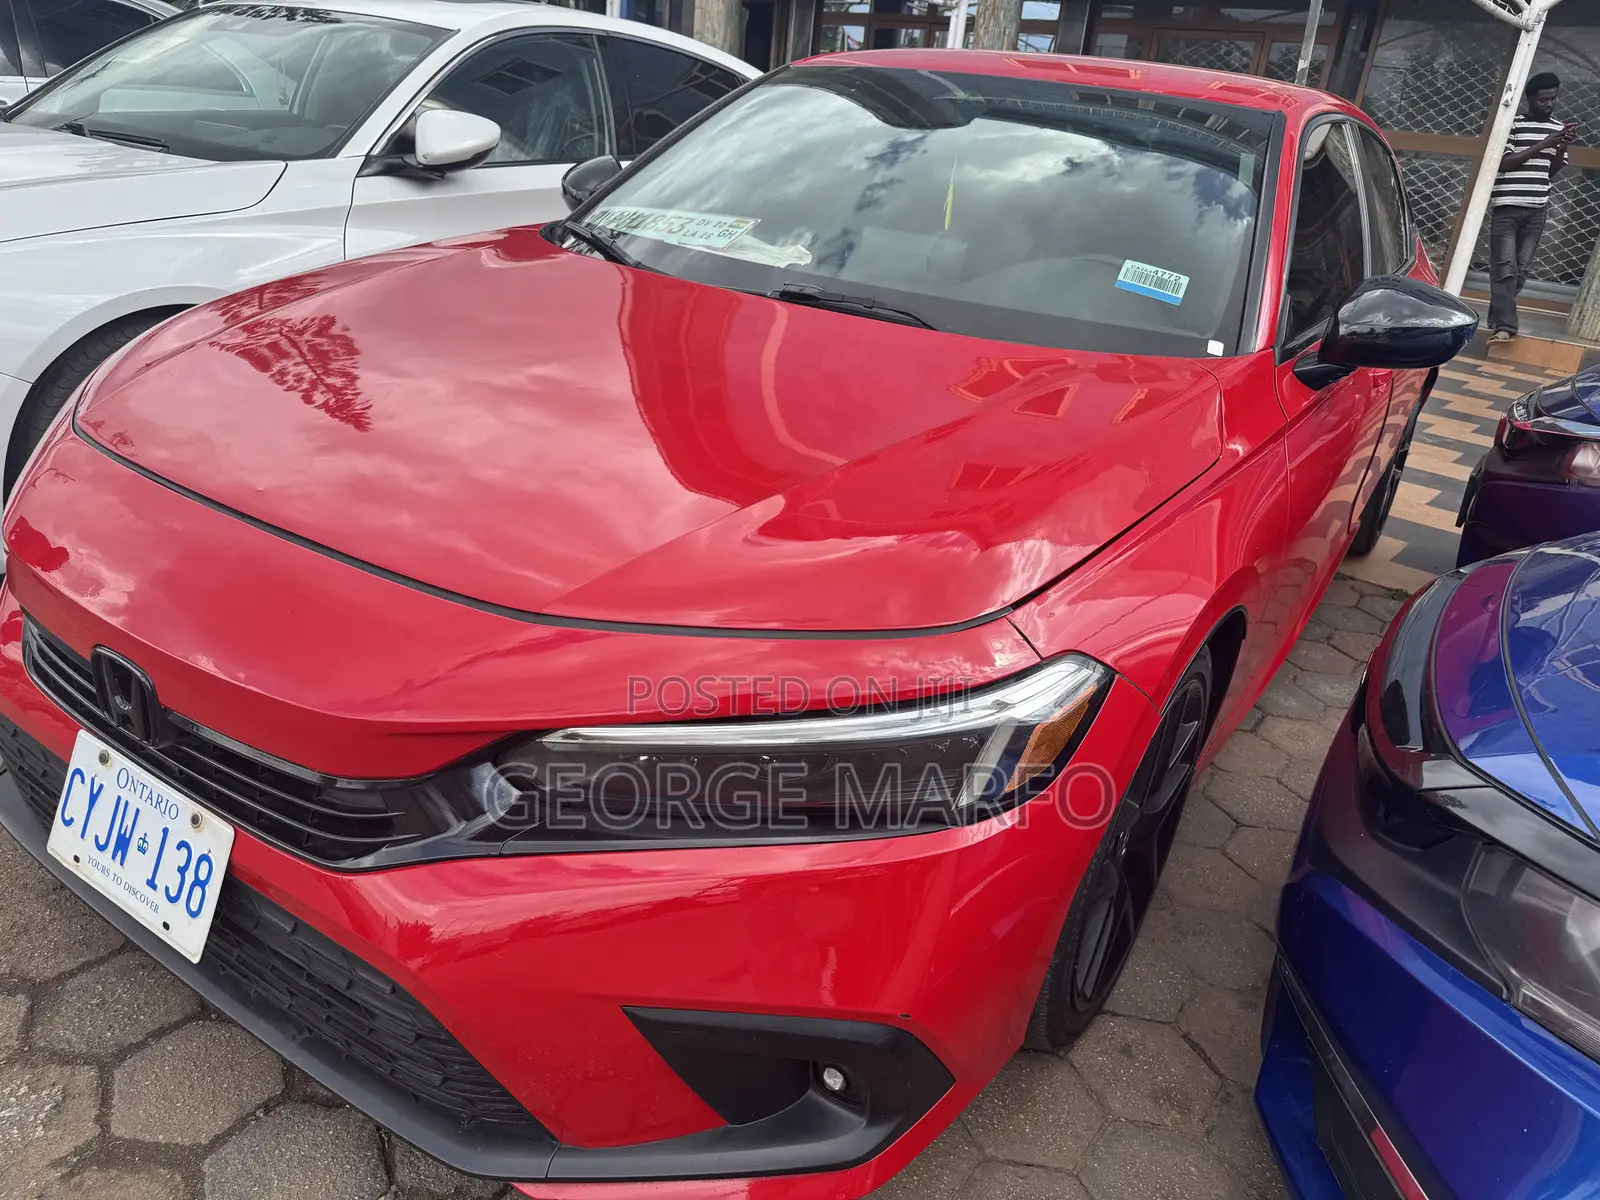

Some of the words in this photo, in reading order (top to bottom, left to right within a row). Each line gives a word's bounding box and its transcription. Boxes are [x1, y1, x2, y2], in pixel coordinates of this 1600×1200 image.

[717, 228, 738, 240] GH
[116, 767, 179, 821] ONTARIO
[60, 767, 141, 867] CYJW
[145, 826, 214, 919] 138
[87, 854, 111, 878] YOURS
[111, 872, 123, 886] TO
[123, 881, 160, 914] DISCOVER
